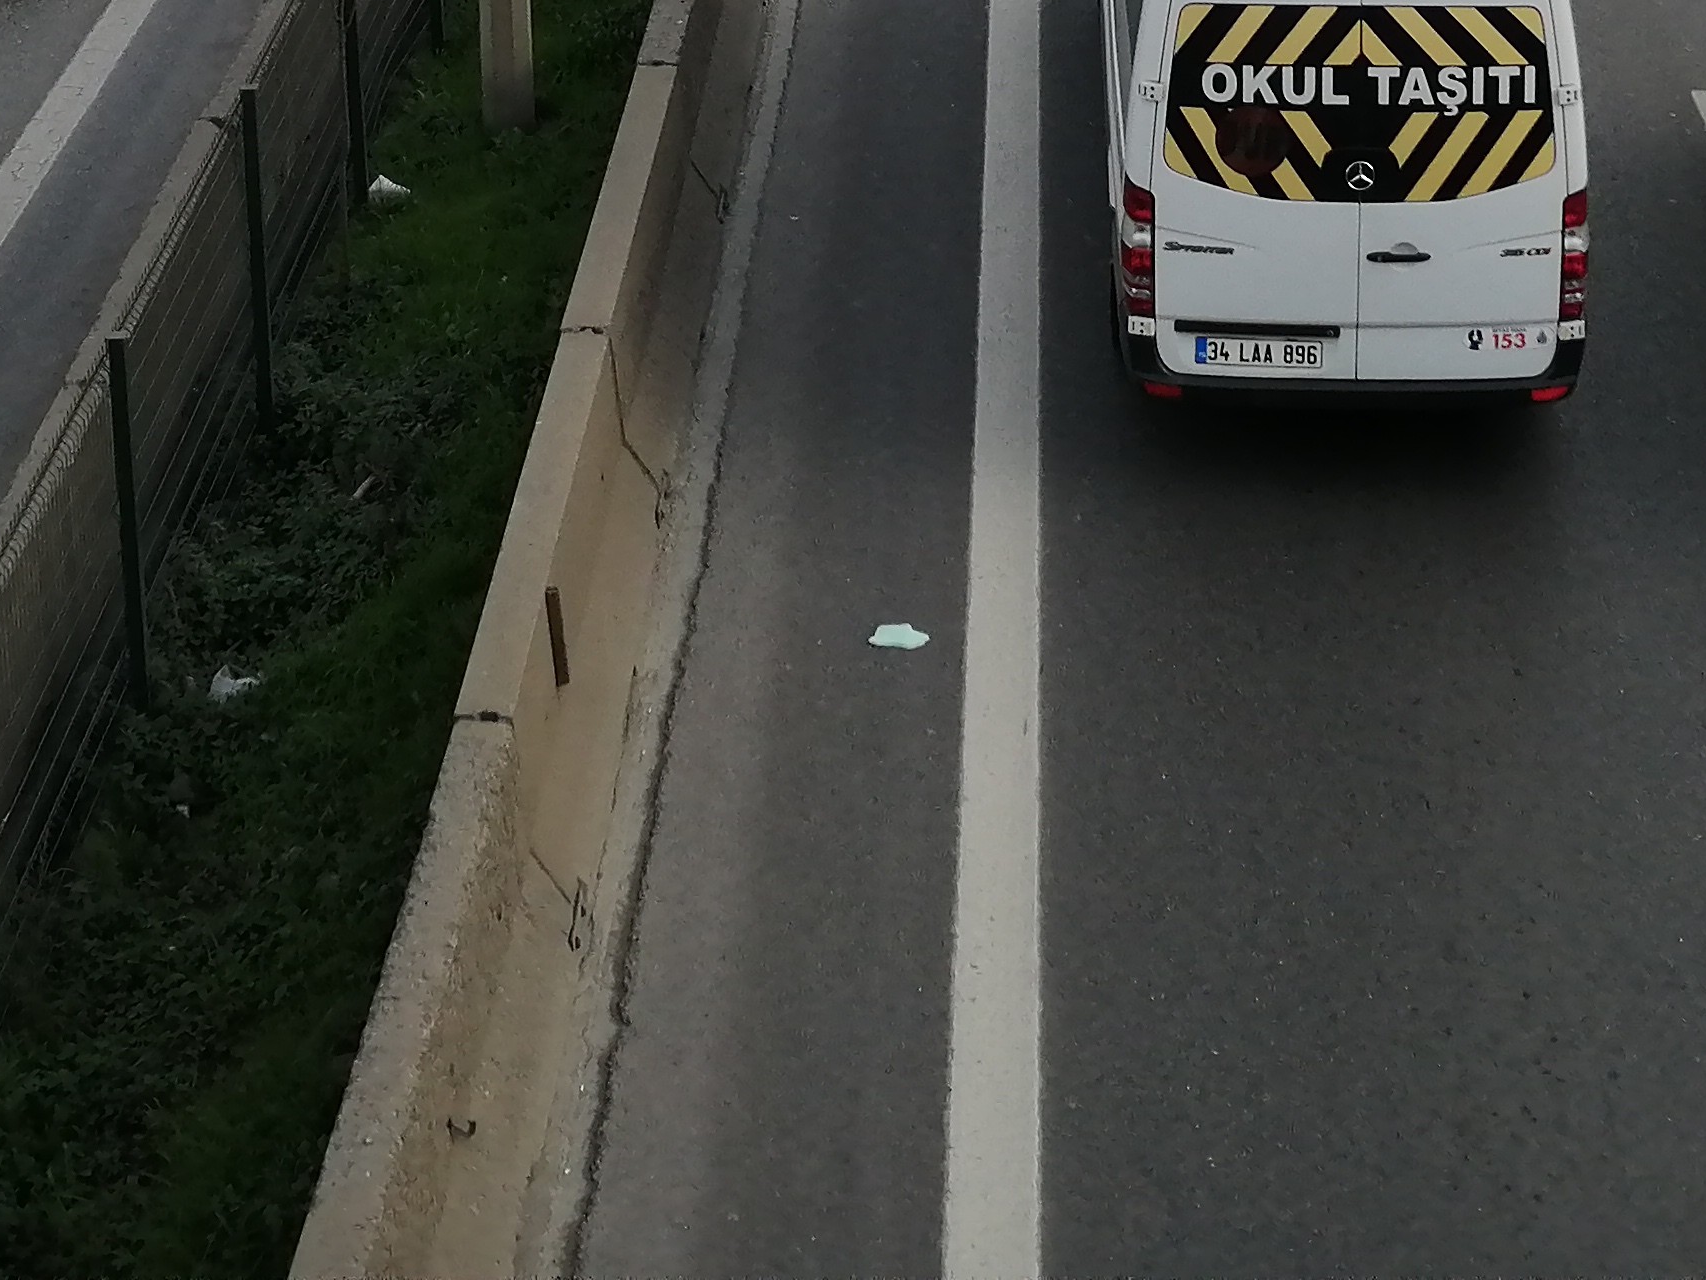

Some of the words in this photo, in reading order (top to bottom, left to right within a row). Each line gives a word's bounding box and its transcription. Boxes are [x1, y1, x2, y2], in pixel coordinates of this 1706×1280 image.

[1202, 63, 1351, 107] OKUL
[1369, 65, 1537, 116] TAŞITI
[1207, 341, 1230, 362] 34
[1239, 342, 1273, 364] LAA
[1283, 343, 1318, 365] 896
[1492, 332, 1527, 350] 153
